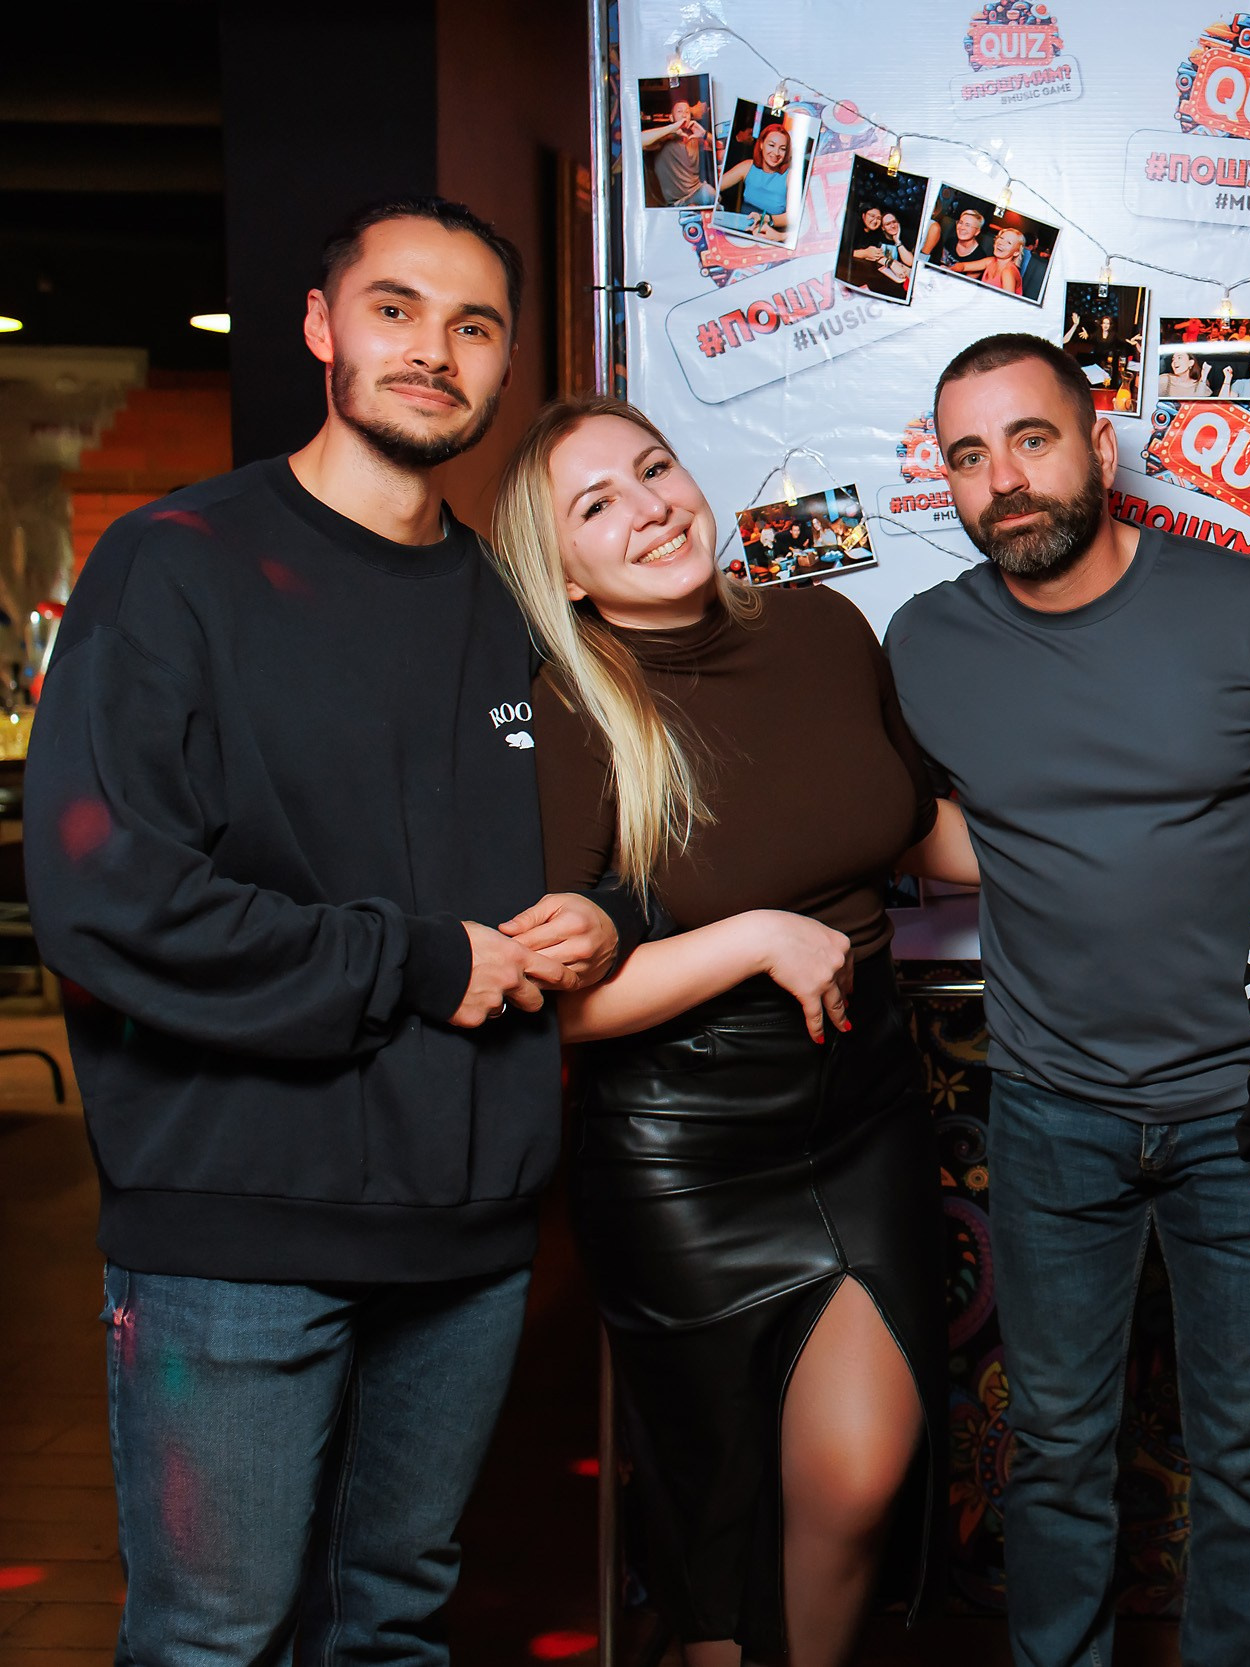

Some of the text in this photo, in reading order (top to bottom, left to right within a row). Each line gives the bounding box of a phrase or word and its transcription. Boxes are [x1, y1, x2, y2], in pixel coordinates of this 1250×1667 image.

[980, 32, 1046, 59] QUIZ
[962, 64, 1071, 100] #ПОШУМИМ?
[1001, 83, 1071, 104] #MUSIC GAME
[697, 270, 850, 357] #ПОШУ
[793, 298, 883, 350] #MUSIC
